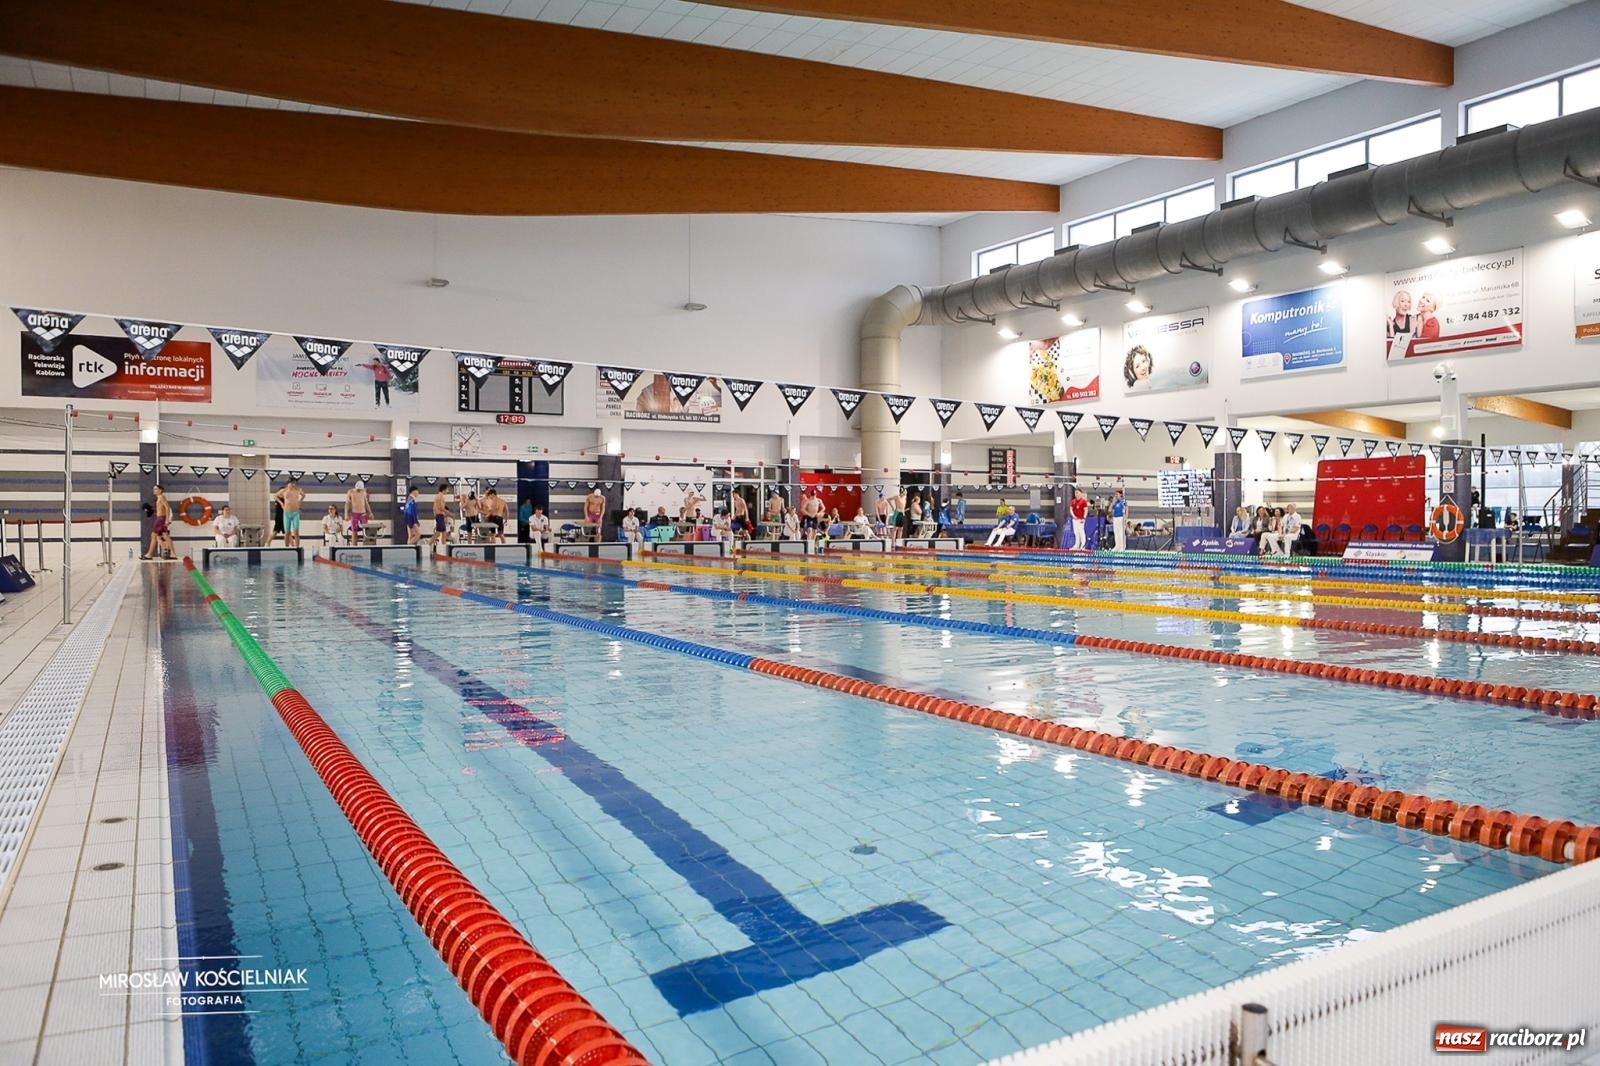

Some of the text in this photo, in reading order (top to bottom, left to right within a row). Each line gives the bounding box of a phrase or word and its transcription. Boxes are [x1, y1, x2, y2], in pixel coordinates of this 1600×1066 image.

[1250, 300, 1325, 325] Komputronik
[1462, 312, 1479, 322] 784
[1481, 309, 1499, 319] 487
[28, 313, 70, 329] arena
[130, 324, 168, 338] arena
[221, 333, 257, 346] arena
[306, 341, 339, 356] arena
[28, 353, 65, 362] Raciborska
[153, 354, 173, 363] tronę
[173, 355, 204, 364] lokalnych
[387, 349, 418, 362] arena
[33, 361, 65, 370] Telewizja
[79, 361, 104, 374] rtk
[464, 356, 494, 368] arena
[35, 369, 66, 377] Kablowa
[124, 361, 205, 382] informacji
[538, 363, 565, 376] arena
[607, 370, 633, 381] arena
[672, 375, 697, 387] arena
[731, 381, 755, 392] arena
[785, 387, 807, 397] arena
[838, 392, 860, 402] arena
[888, 397, 909, 407] arena
[937, 402, 955, 411] arena
[500, 415, 525, 423] 17:03
